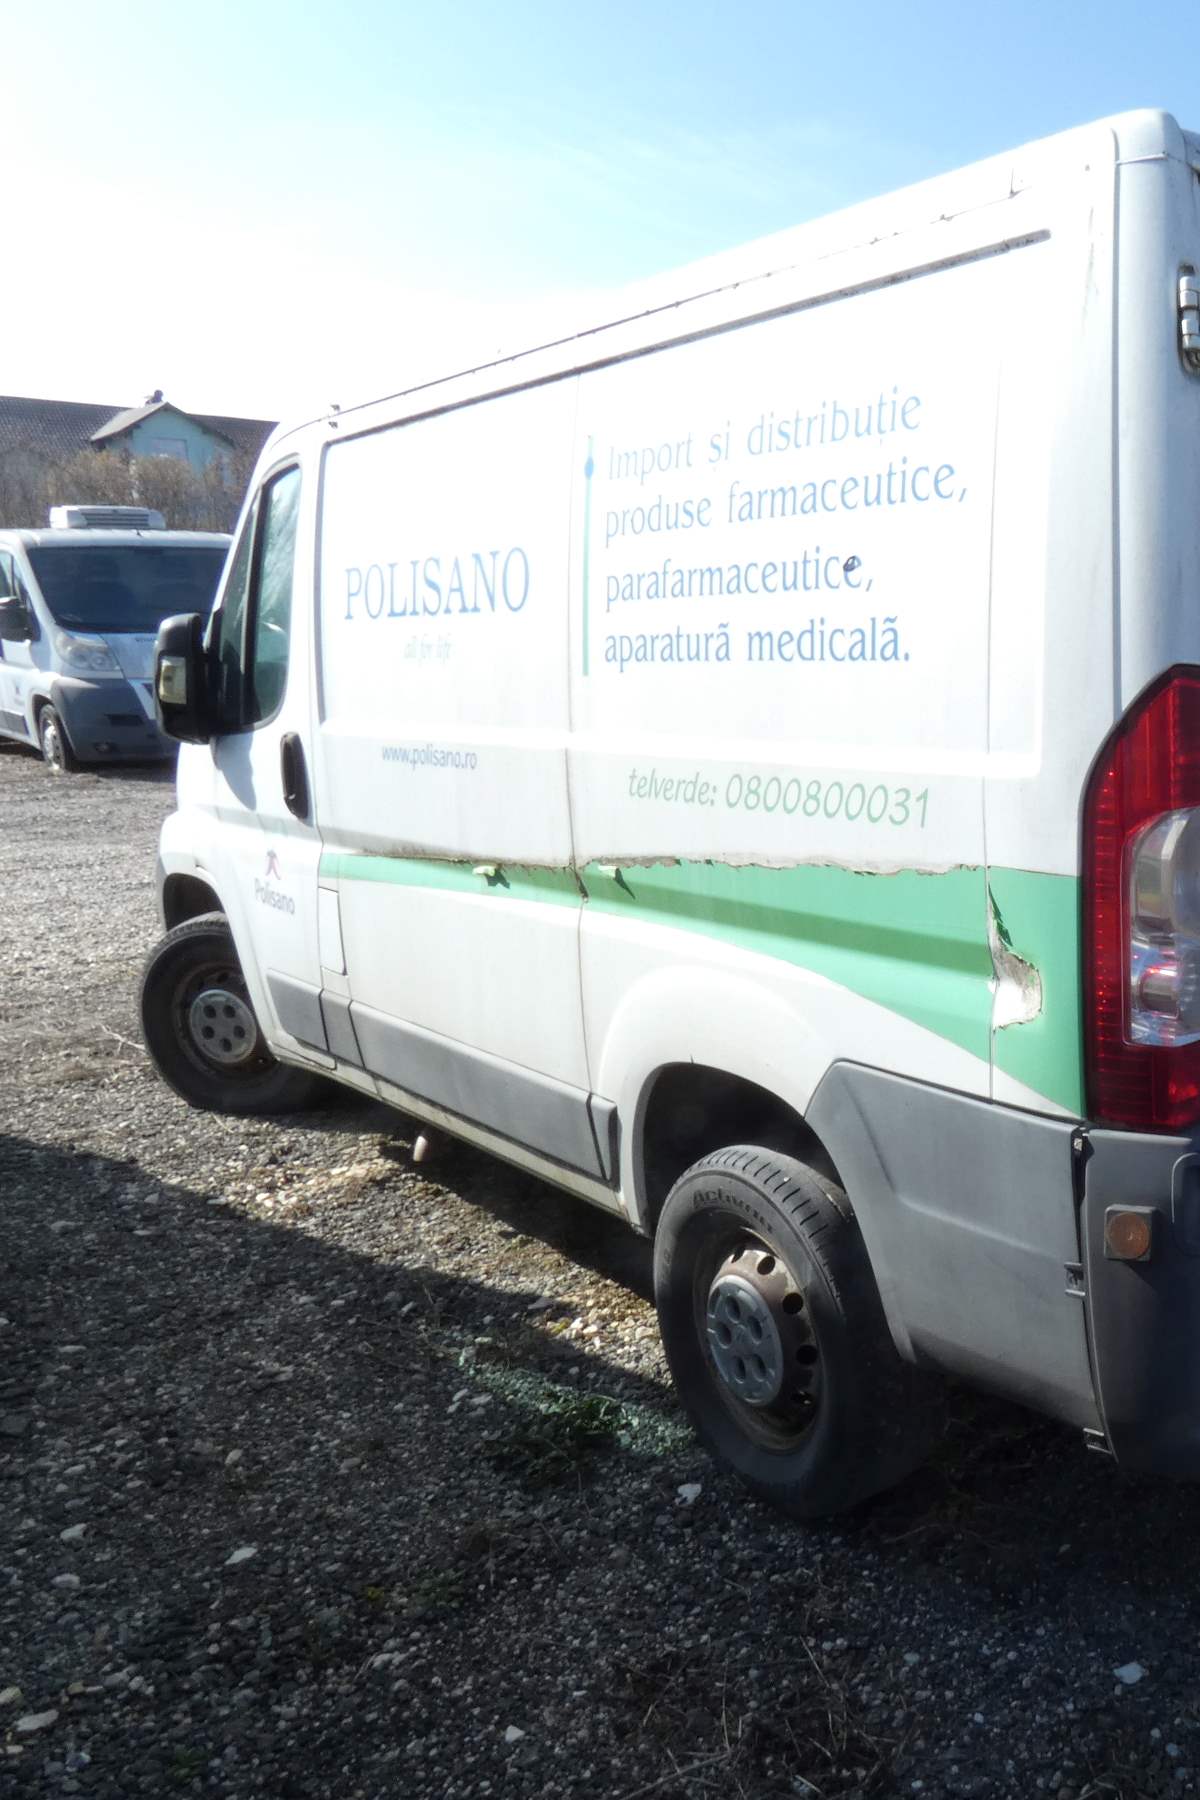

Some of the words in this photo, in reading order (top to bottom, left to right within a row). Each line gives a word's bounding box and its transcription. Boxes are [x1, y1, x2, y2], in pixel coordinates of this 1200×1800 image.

[607, 431, 694, 486] Import
[605, 494, 713, 549] produse
[728, 455, 967, 523] farmaceutice,
[344, 546, 529, 620] POLISANO
[605, 545, 873, 613] parafarmaceutice,
[382, 744, 478, 771] www.polisano.ro
[628, 767, 717, 807] telverde:
[725, 773, 929, 829] 0800800031
[254, 877, 296, 915] Polisano
